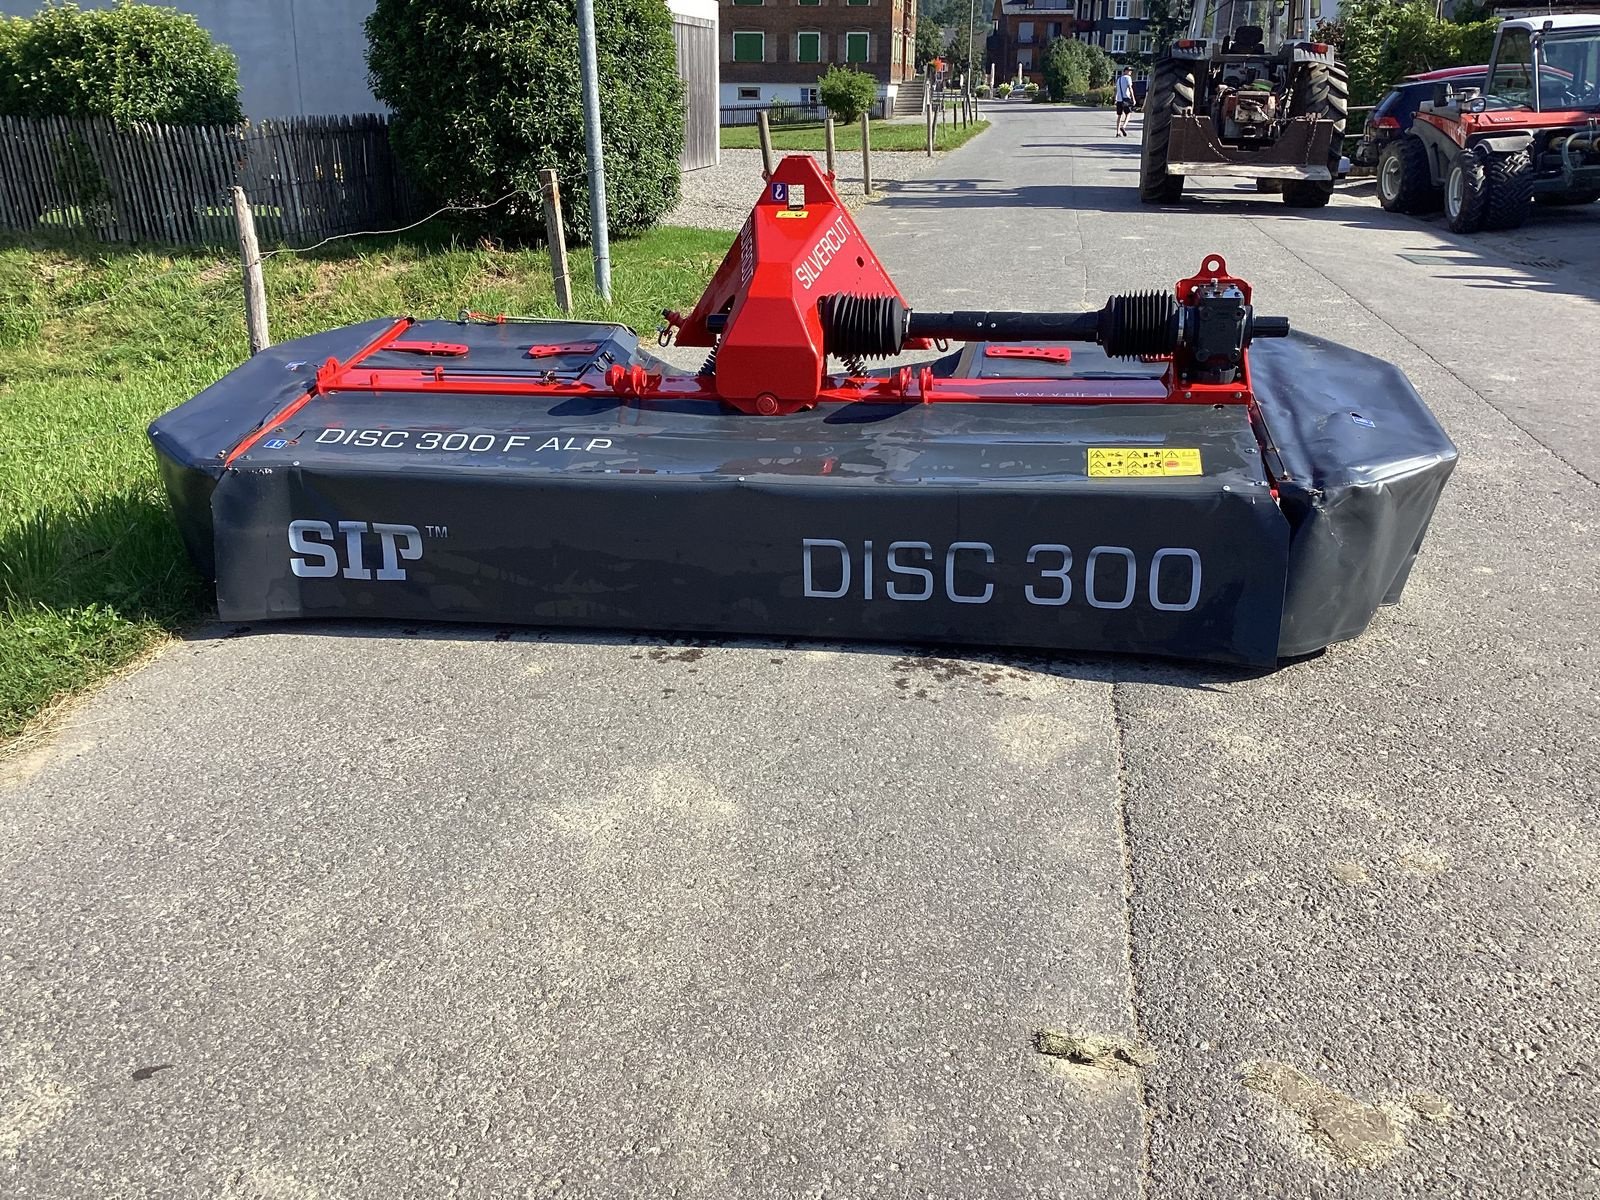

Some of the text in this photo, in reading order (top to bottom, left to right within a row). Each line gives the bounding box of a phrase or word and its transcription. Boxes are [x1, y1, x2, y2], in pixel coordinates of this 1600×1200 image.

[795, 215, 851, 290] SILVERCUT
[315, 428, 613, 452] DISC 300 F ALP
[288, 519, 424, 581] SIP
[802, 538, 1202, 612] DISC 300
